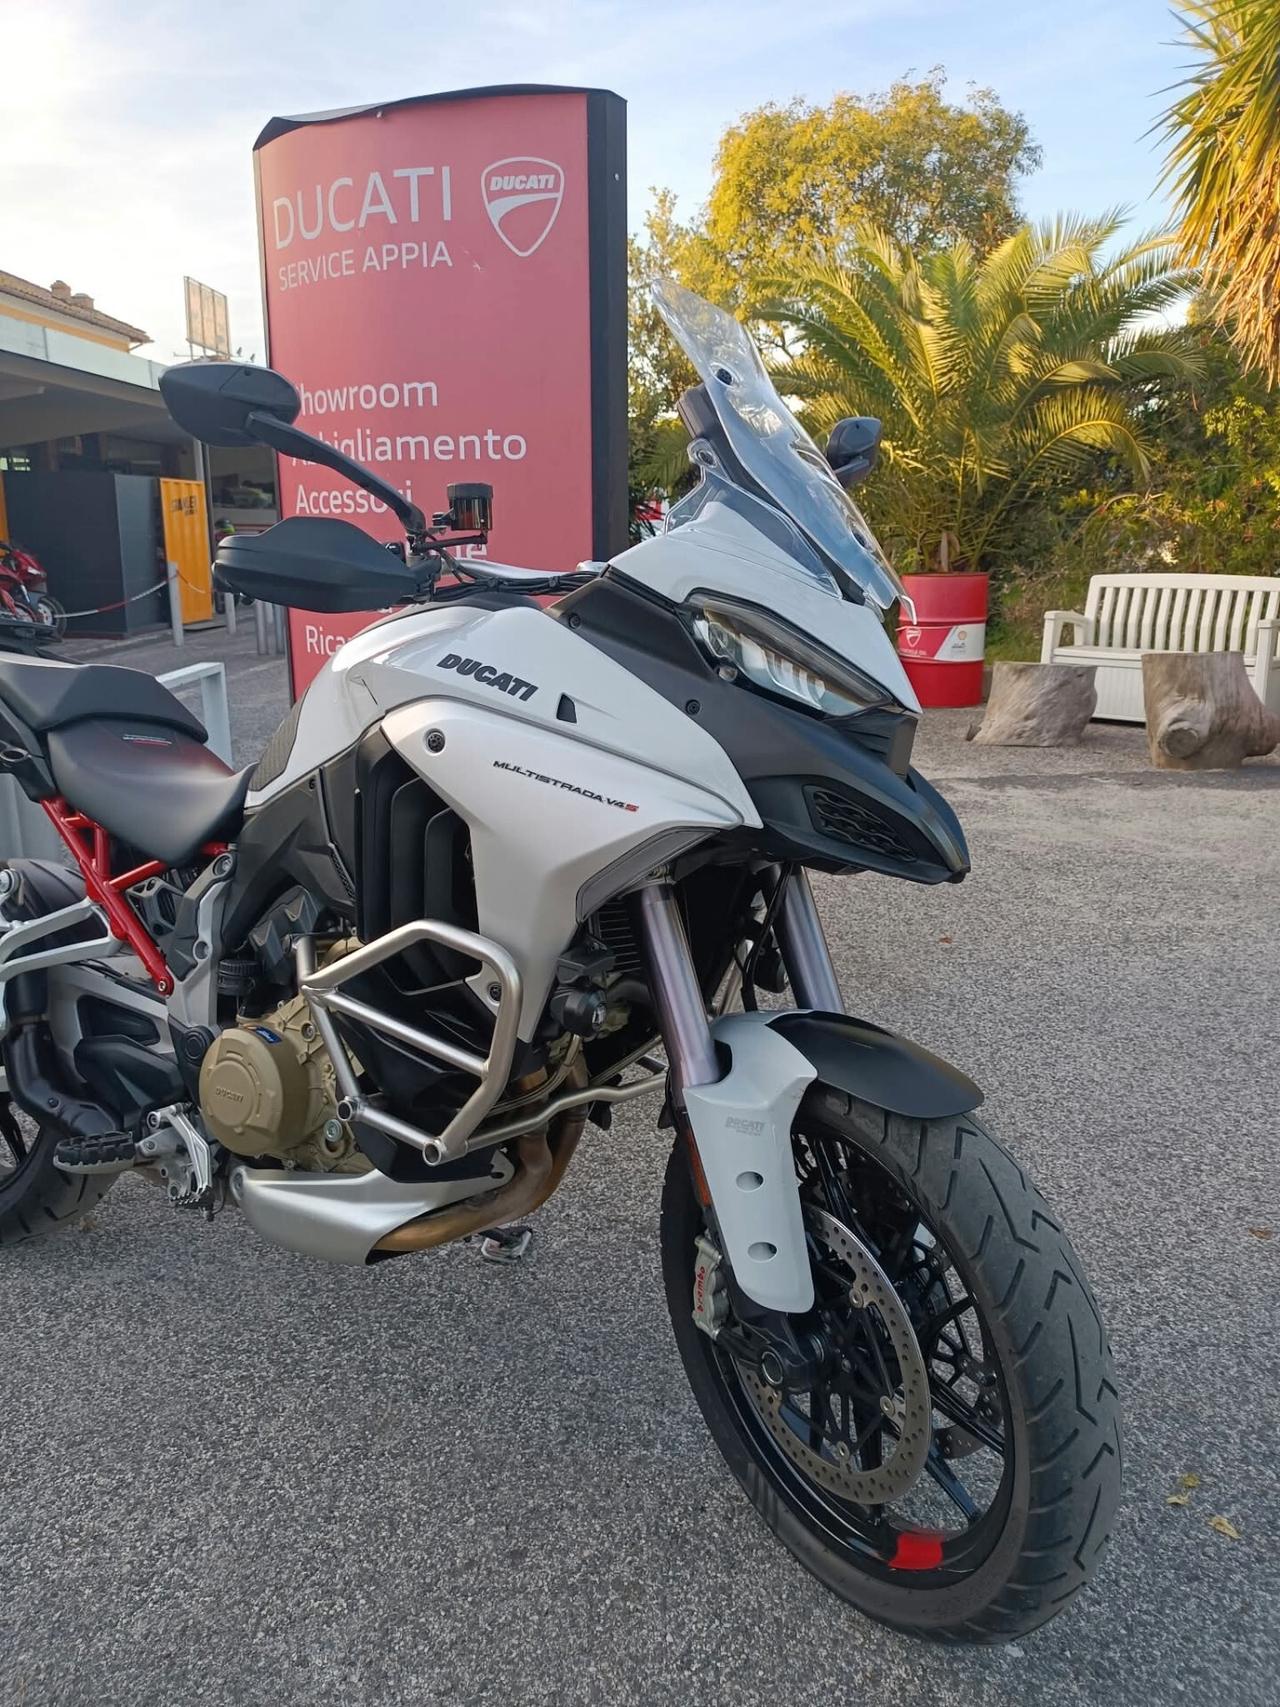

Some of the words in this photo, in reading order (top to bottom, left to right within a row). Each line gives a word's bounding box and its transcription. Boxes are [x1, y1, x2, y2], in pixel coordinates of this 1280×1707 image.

[490, 174, 556, 192] DUCATI
[273, 166, 452, 250] DUCATI
[278, 250, 355, 292] SERVICE
[362, 241, 453, 273] APPIA
[296, 381, 439, 416] howroom
[291, 429, 527, 467] igliamento
[295, 480, 413, 515] Accessoi
[437, 653, 539, 702] DUCATI
[493, 760, 603, 803] MULTISTRADA
[696, 1265, 706, 1313] brembo
